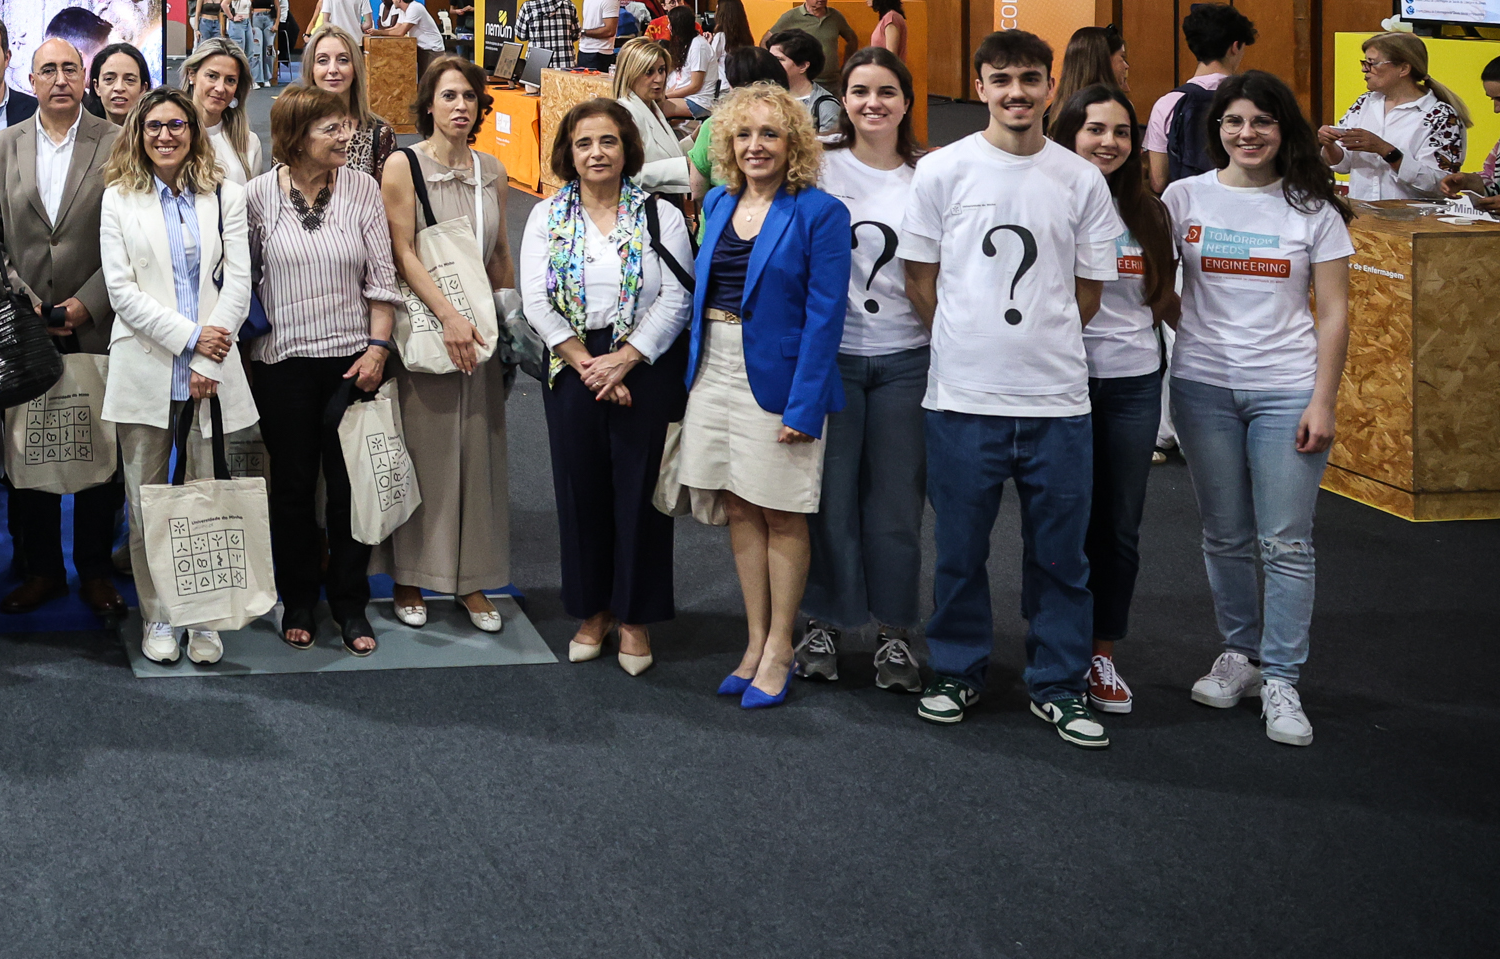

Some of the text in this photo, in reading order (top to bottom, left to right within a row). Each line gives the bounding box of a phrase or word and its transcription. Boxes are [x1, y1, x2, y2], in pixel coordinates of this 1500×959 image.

[1208, 229, 1273, 246] TOMORROW
[1206, 243, 1245, 256] NEEDS
[851, 220, 899, 315] ?
[982, 224, 1038, 326] ?
[1205, 257, 1287, 275] ENGINEERING
[1353, 262, 1405, 280] de Enfermagem
[191, 516, 221, 526] Universidade
